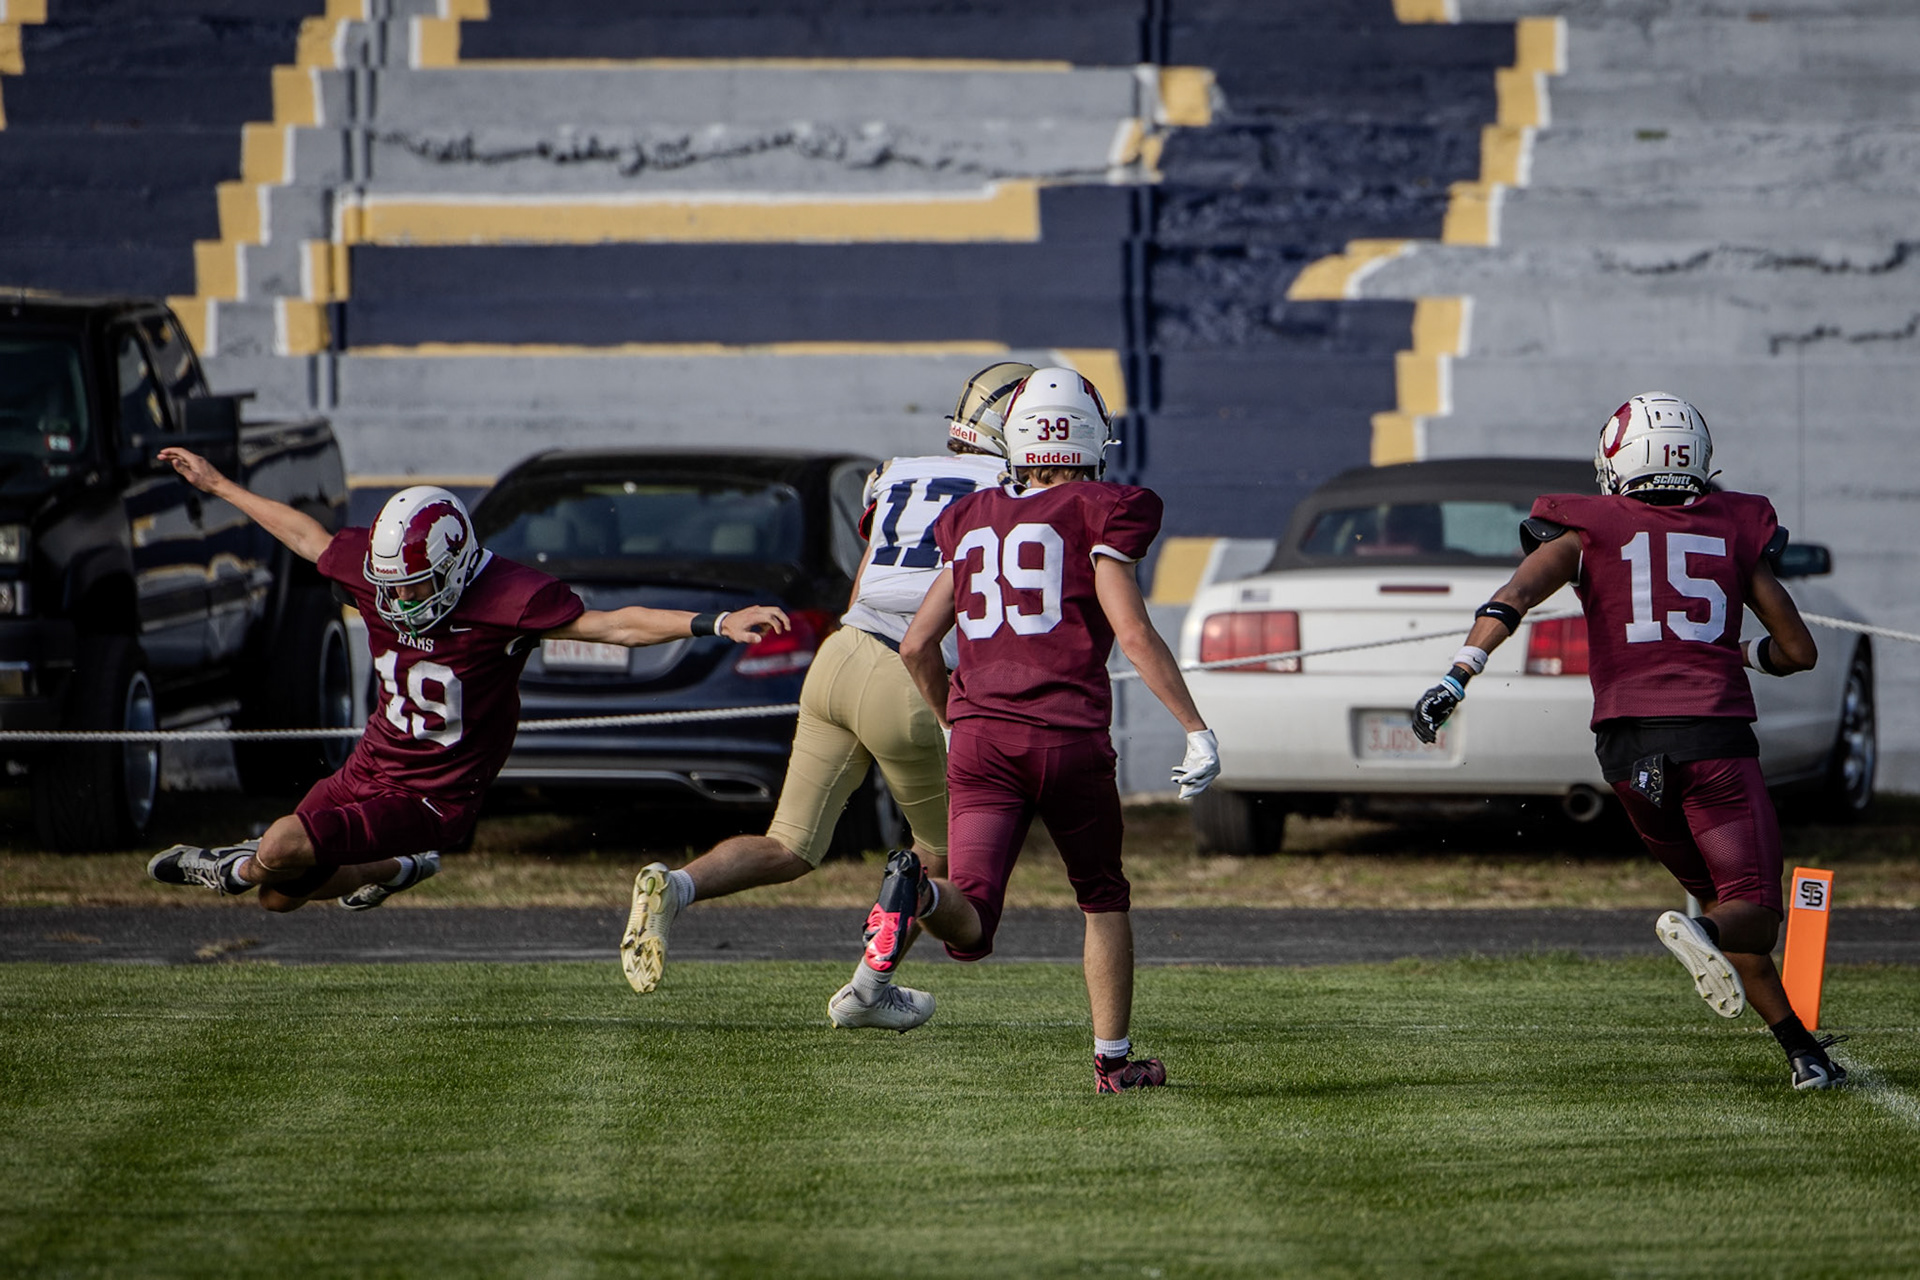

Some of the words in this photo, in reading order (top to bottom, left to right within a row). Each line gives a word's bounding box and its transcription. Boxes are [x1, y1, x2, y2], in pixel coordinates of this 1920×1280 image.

[1025, 452, 1081, 464] Riddell
[871, 477, 976, 568] 17
[953, 523, 1064, 640] 39
[1621, 532, 1727, 643] 15
[397, 631, 435, 653] RAMS
[374, 649, 463, 747] 19
